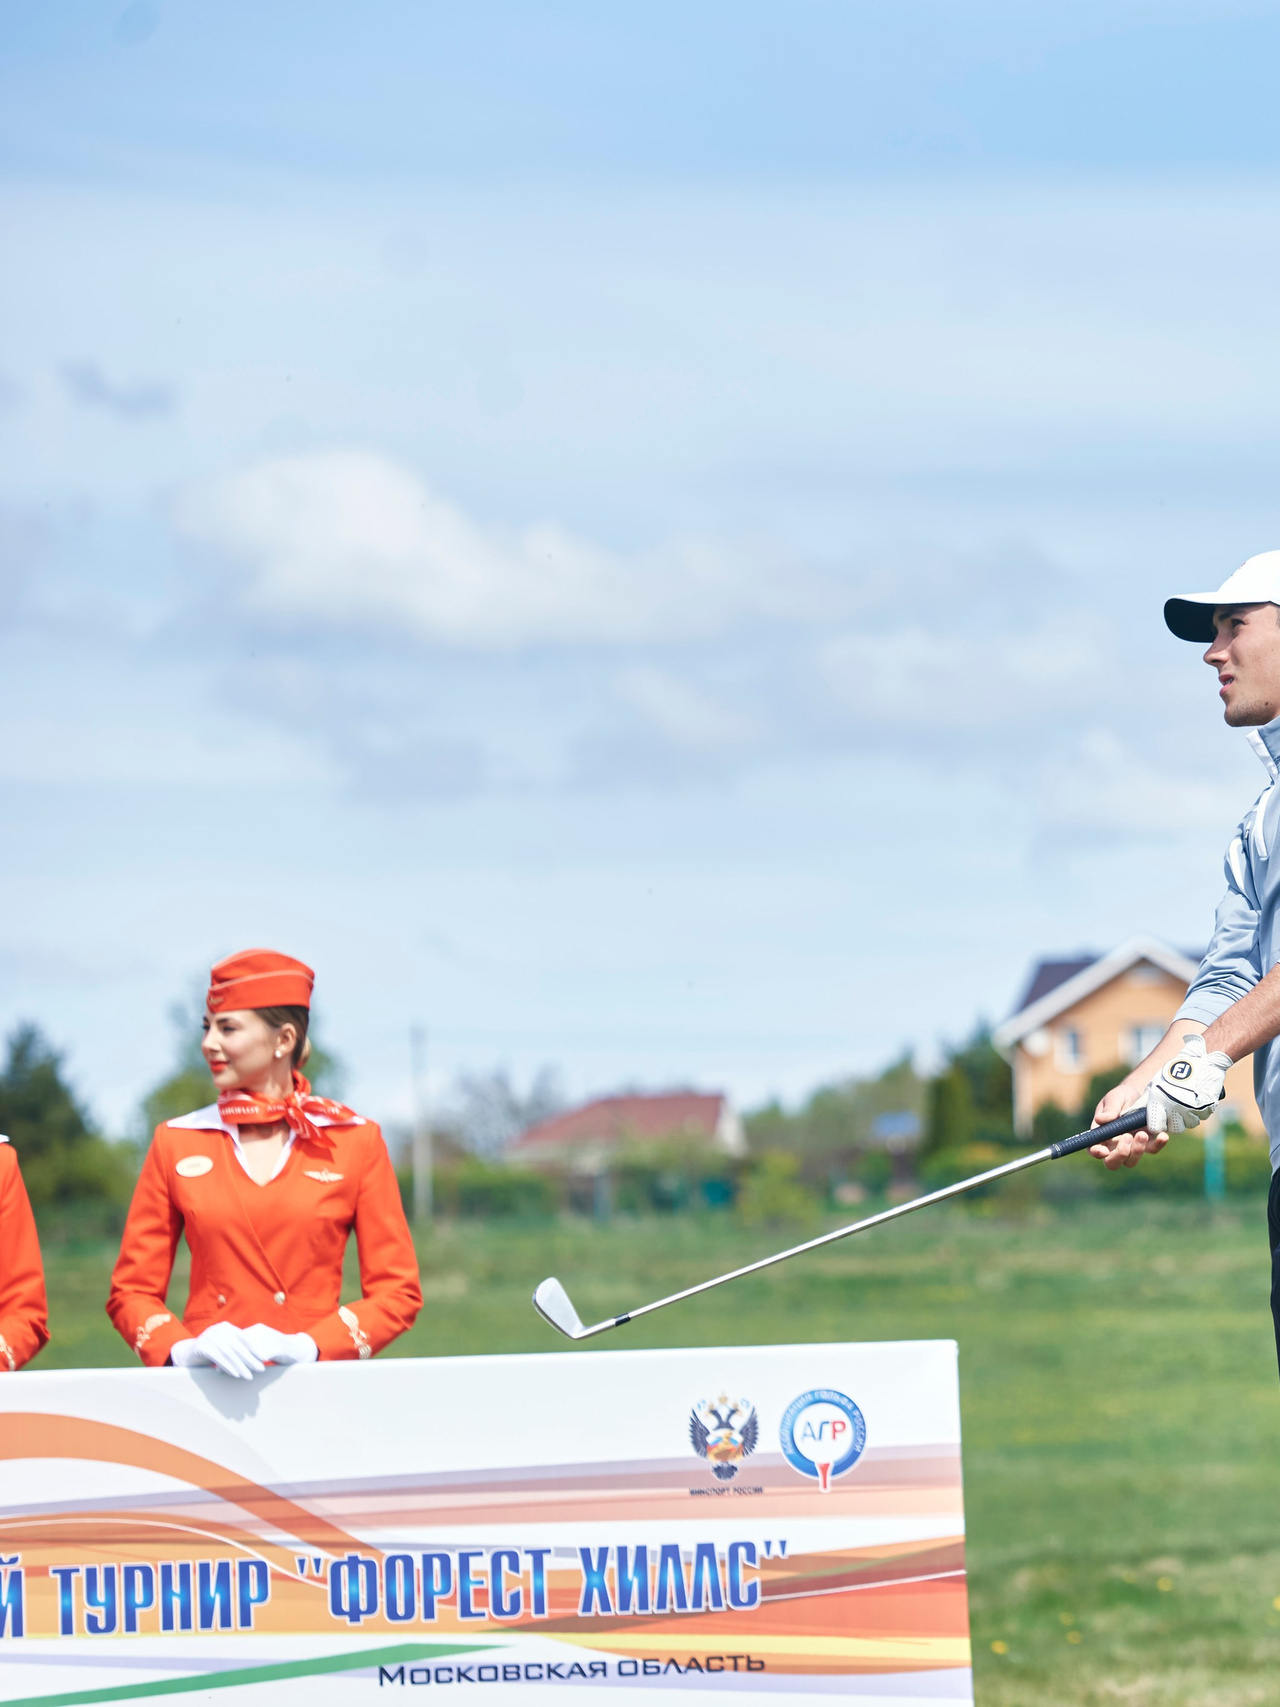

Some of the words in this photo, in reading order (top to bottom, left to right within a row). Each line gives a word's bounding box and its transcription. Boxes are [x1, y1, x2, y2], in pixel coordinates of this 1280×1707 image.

[801, 1420, 846, 1441] АГР
[51, 1560, 269, 1636] ТУРНИР
[297, 1549, 552, 1624] "ФОРЕСТ
[578, 1540, 788, 1615] ХИЛЛС"
